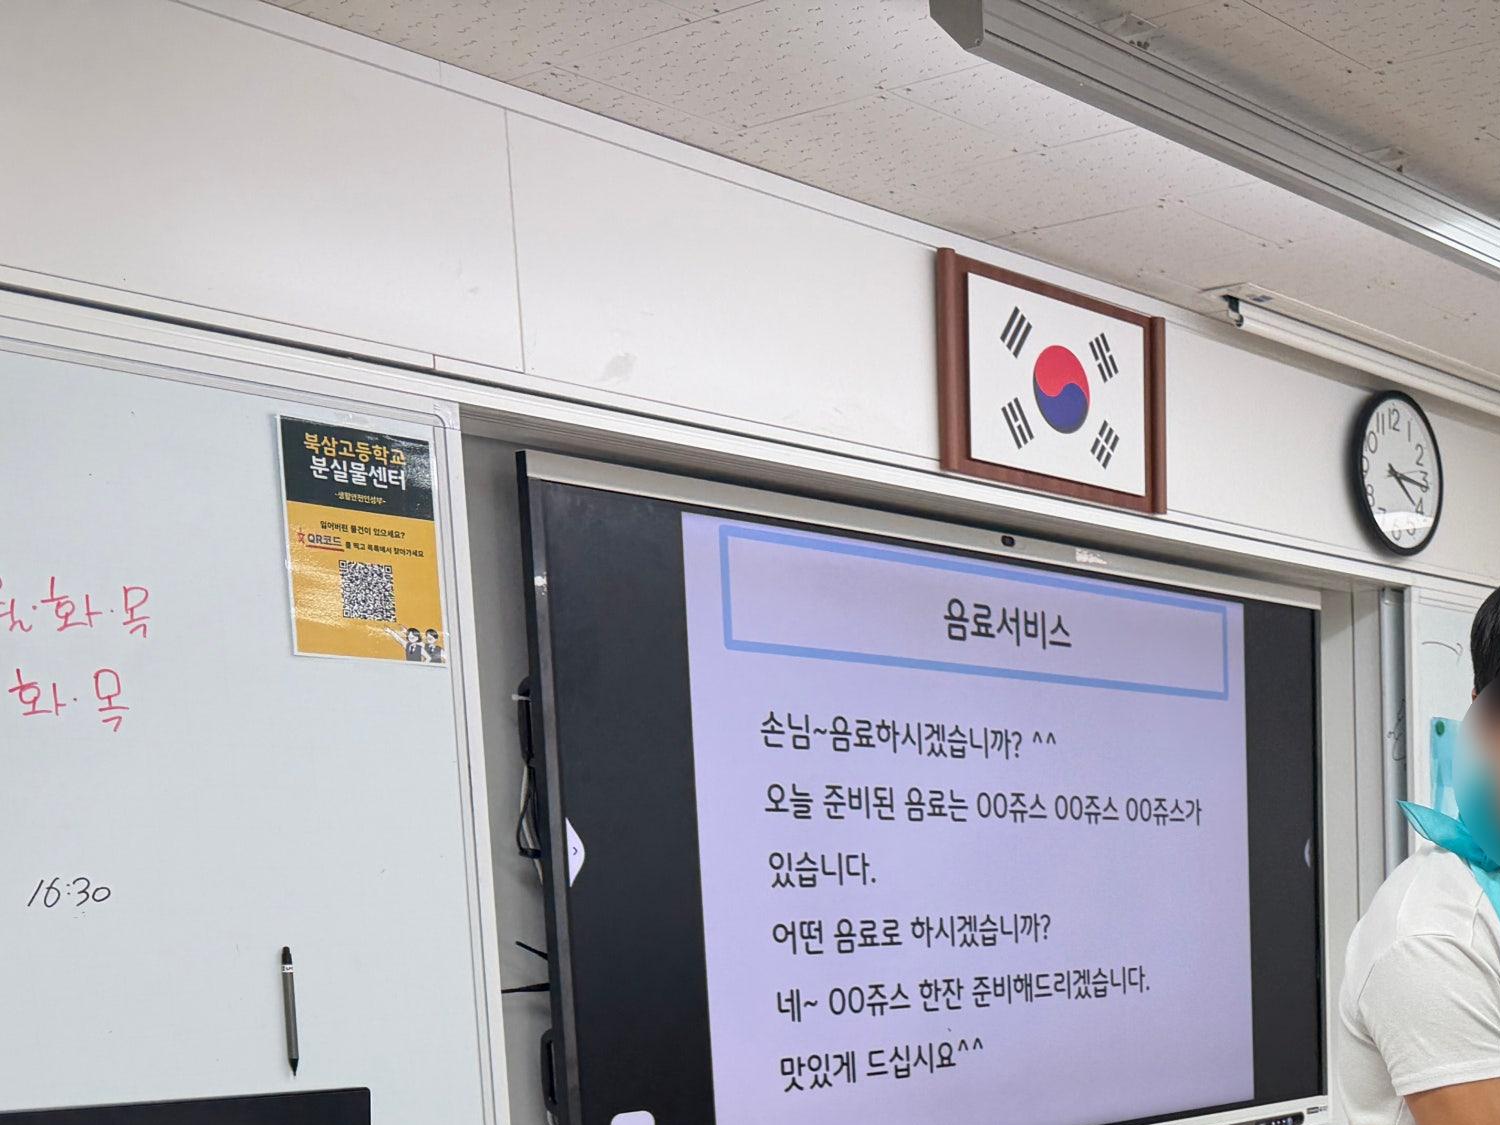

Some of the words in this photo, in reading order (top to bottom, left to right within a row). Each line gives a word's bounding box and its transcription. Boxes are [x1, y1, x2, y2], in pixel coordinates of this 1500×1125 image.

[1376, 412, 1384, 435] 11
[1388, 408, 1400, 432] 12
[303, 432, 407, 466] 북삼고등학교
[1415, 443, 1424, 466] 2
[310, 455, 407, 491] 분실물센터
[1367, 484, 1375, 507] 8
[1415, 496, 1424, 516] 4
[307, 533, 343, 546] QR코드
[943, 597, 1072, 650] 음료서비스
[760, 710, 1023, 760] 손님~음료하시겠습니까?
[764, 783, 813, 821] 오늘
[822, 784, 896, 822] 준비된
[904, 788, 969, 825] 음료는
[768, 852, 877, 889] 있습니다.
[27, 876, 111, 909] 16:30
[772, 920, 824, 956] 어떤
[833, 918, 903, 954] 음료로
[910, 913, 1051, 949] 하시겠습니까?
[776, 988, 818, 1022] 네~
[919, 978, 964, 1013] 한잔
[971, 965, 1150, 1009] 준비해드리겠습니다.
[780, 1051, 857, 1093] 맛있게
